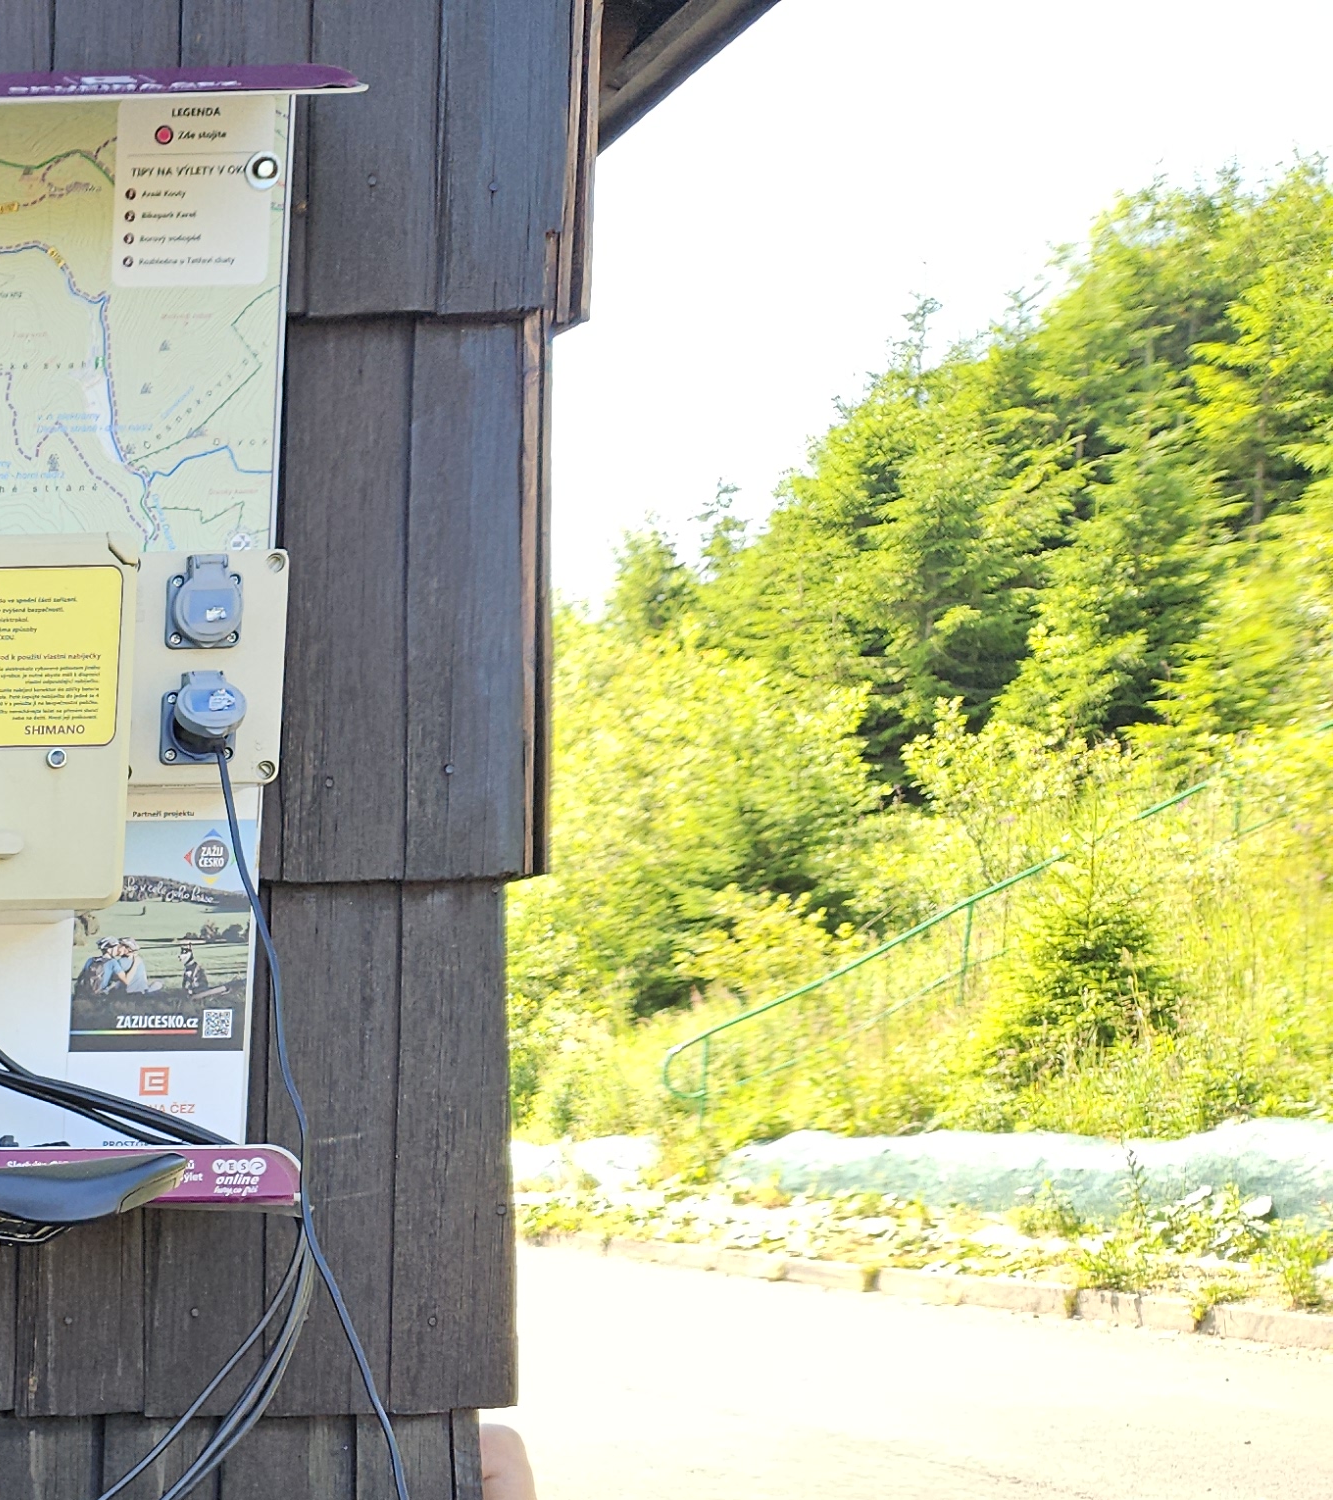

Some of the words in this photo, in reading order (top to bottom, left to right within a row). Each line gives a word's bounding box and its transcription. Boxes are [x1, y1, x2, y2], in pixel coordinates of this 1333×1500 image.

[171, 107, 221, 117] LEGENDA
[24, 724, 85, 737] SHIMANO
[132, 809, 162, 818] Partneři
[163, 809, 195, 819] projektu
[201, 845, 223, 856] ZAŽIJ
[198, 856, 225, 868] ČESKO
[116, 1014, 199, 1030] ZAZIJCESKO.cz
[170, 1102, 196, 1115] ČEZ
[215, 1161, 247, 1171] YES
[215, 1174, 261, 1185] online
